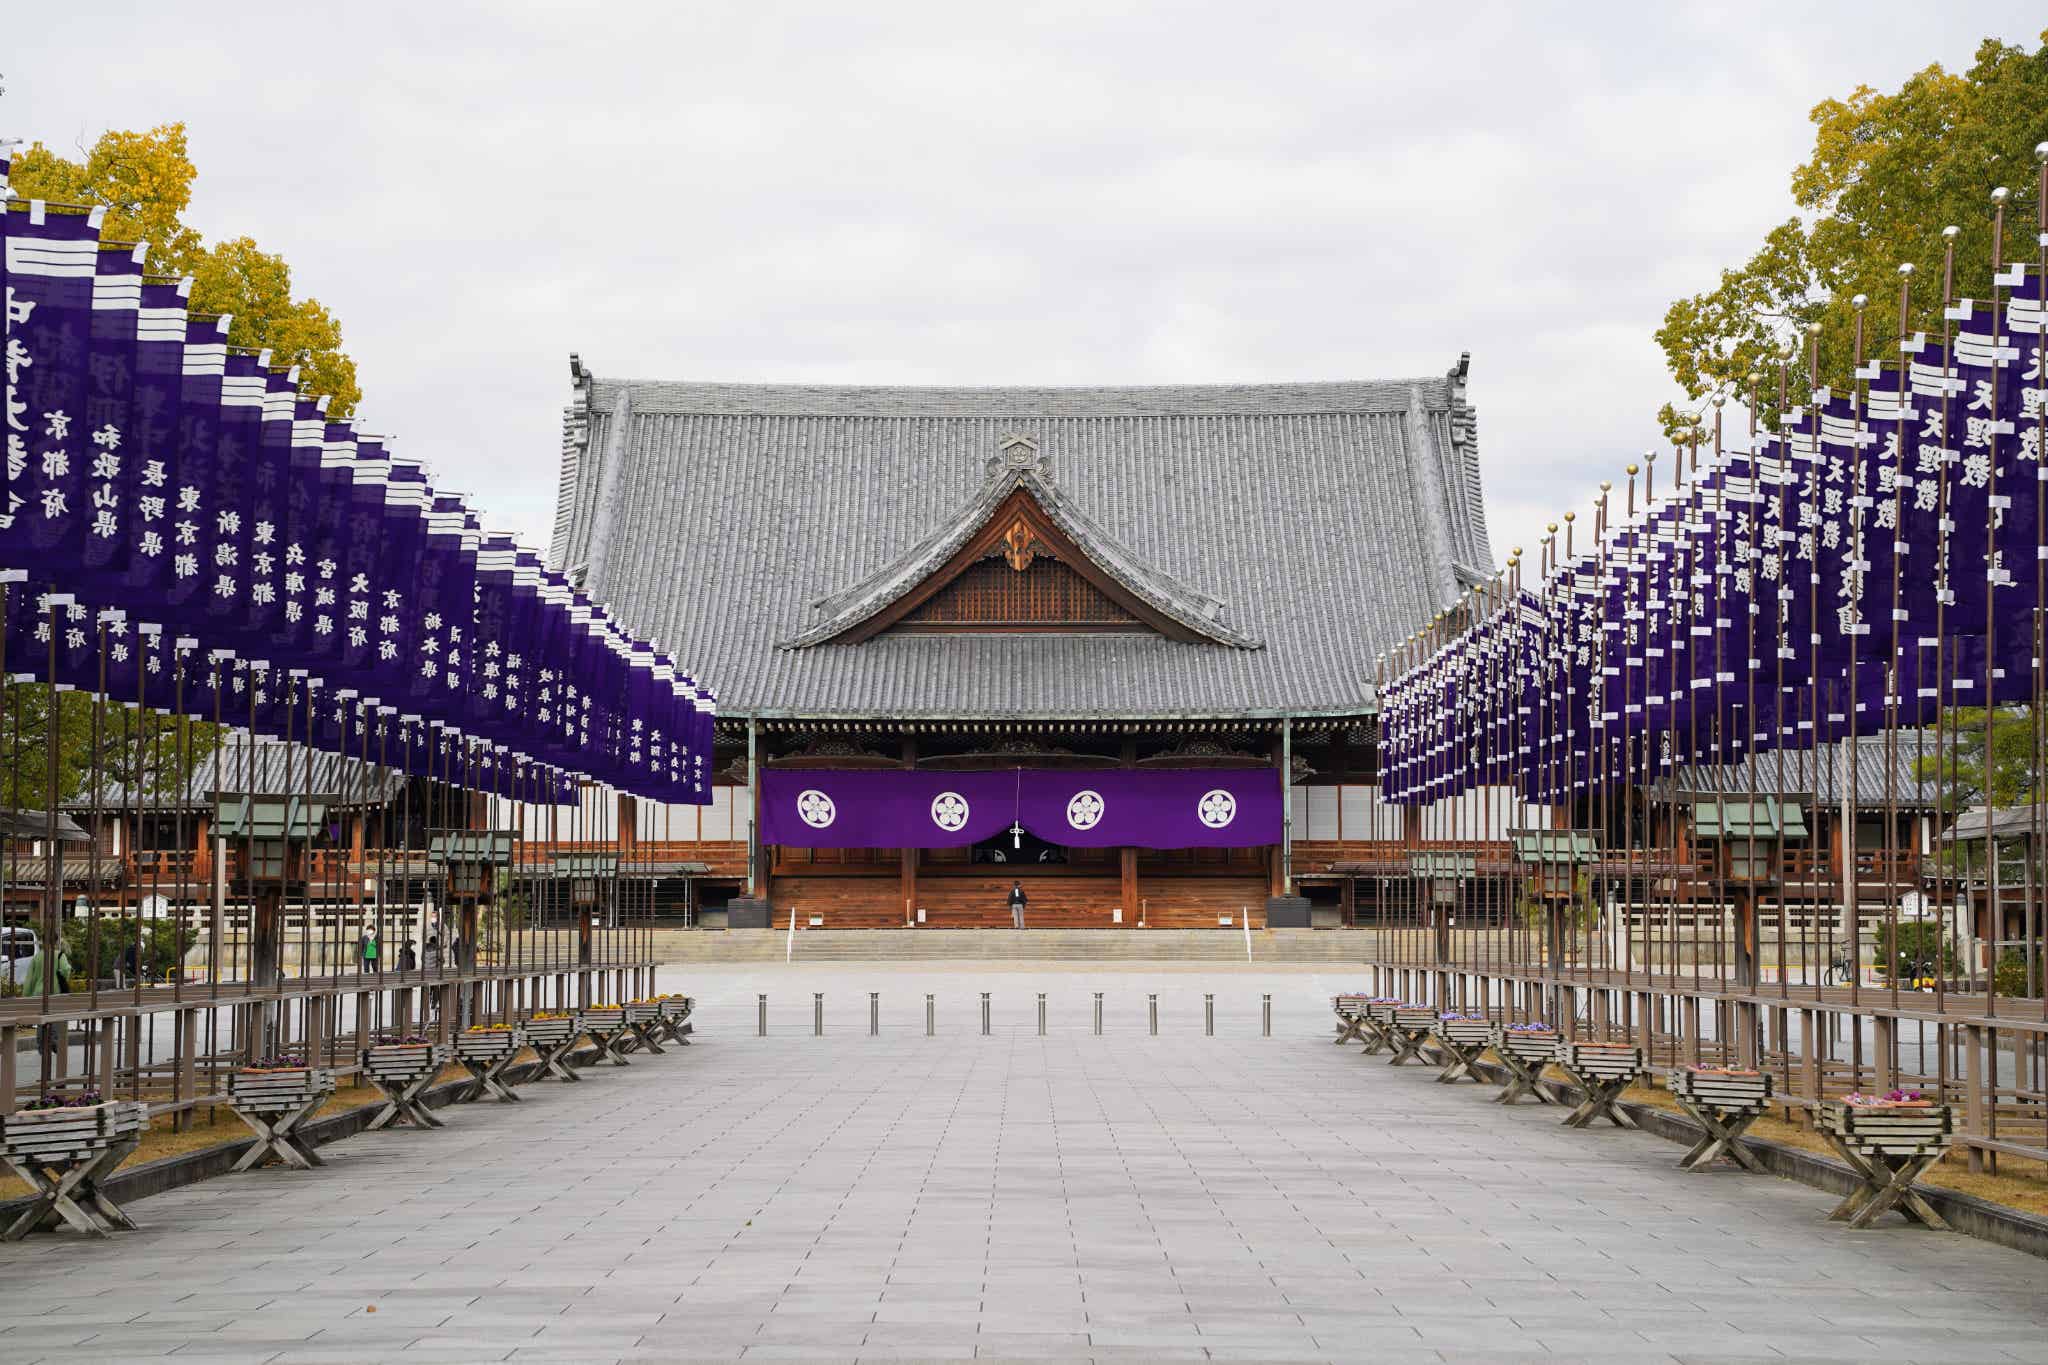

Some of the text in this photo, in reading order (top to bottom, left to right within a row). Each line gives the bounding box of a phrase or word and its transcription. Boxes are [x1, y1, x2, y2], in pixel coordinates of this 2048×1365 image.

[1874, 430, 1900, 530] 天理教
[1914, 408, 1941, 513] 天理教
[1960, 379, 1993, 489] 天理教
[1760, 494, 1782, 582] 天理教
[1796, 471, 1820, 561] 天理教
[1821, 456, 1845, 550] 天理教
[1734, 511, 1753, 596] 天理教
[1576, 602, 1593, 666] 天理教
